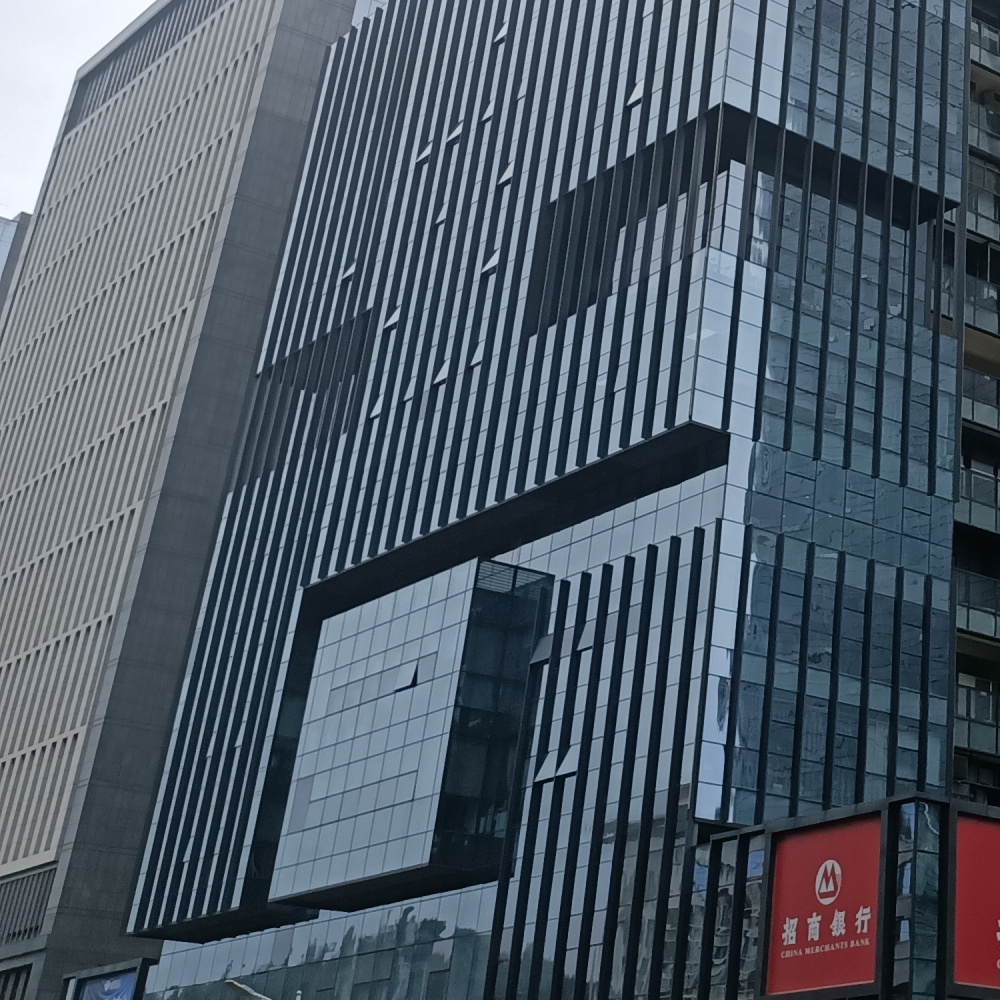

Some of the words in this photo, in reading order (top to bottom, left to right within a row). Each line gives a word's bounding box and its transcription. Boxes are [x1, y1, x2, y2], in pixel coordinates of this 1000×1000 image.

[782, 905, 871, 946] 招商银行
[780, 948, 803, 959] CHINA
[804, 940, 849, 956] MERCHANTS
[849, 937, 870, 948] BANK
